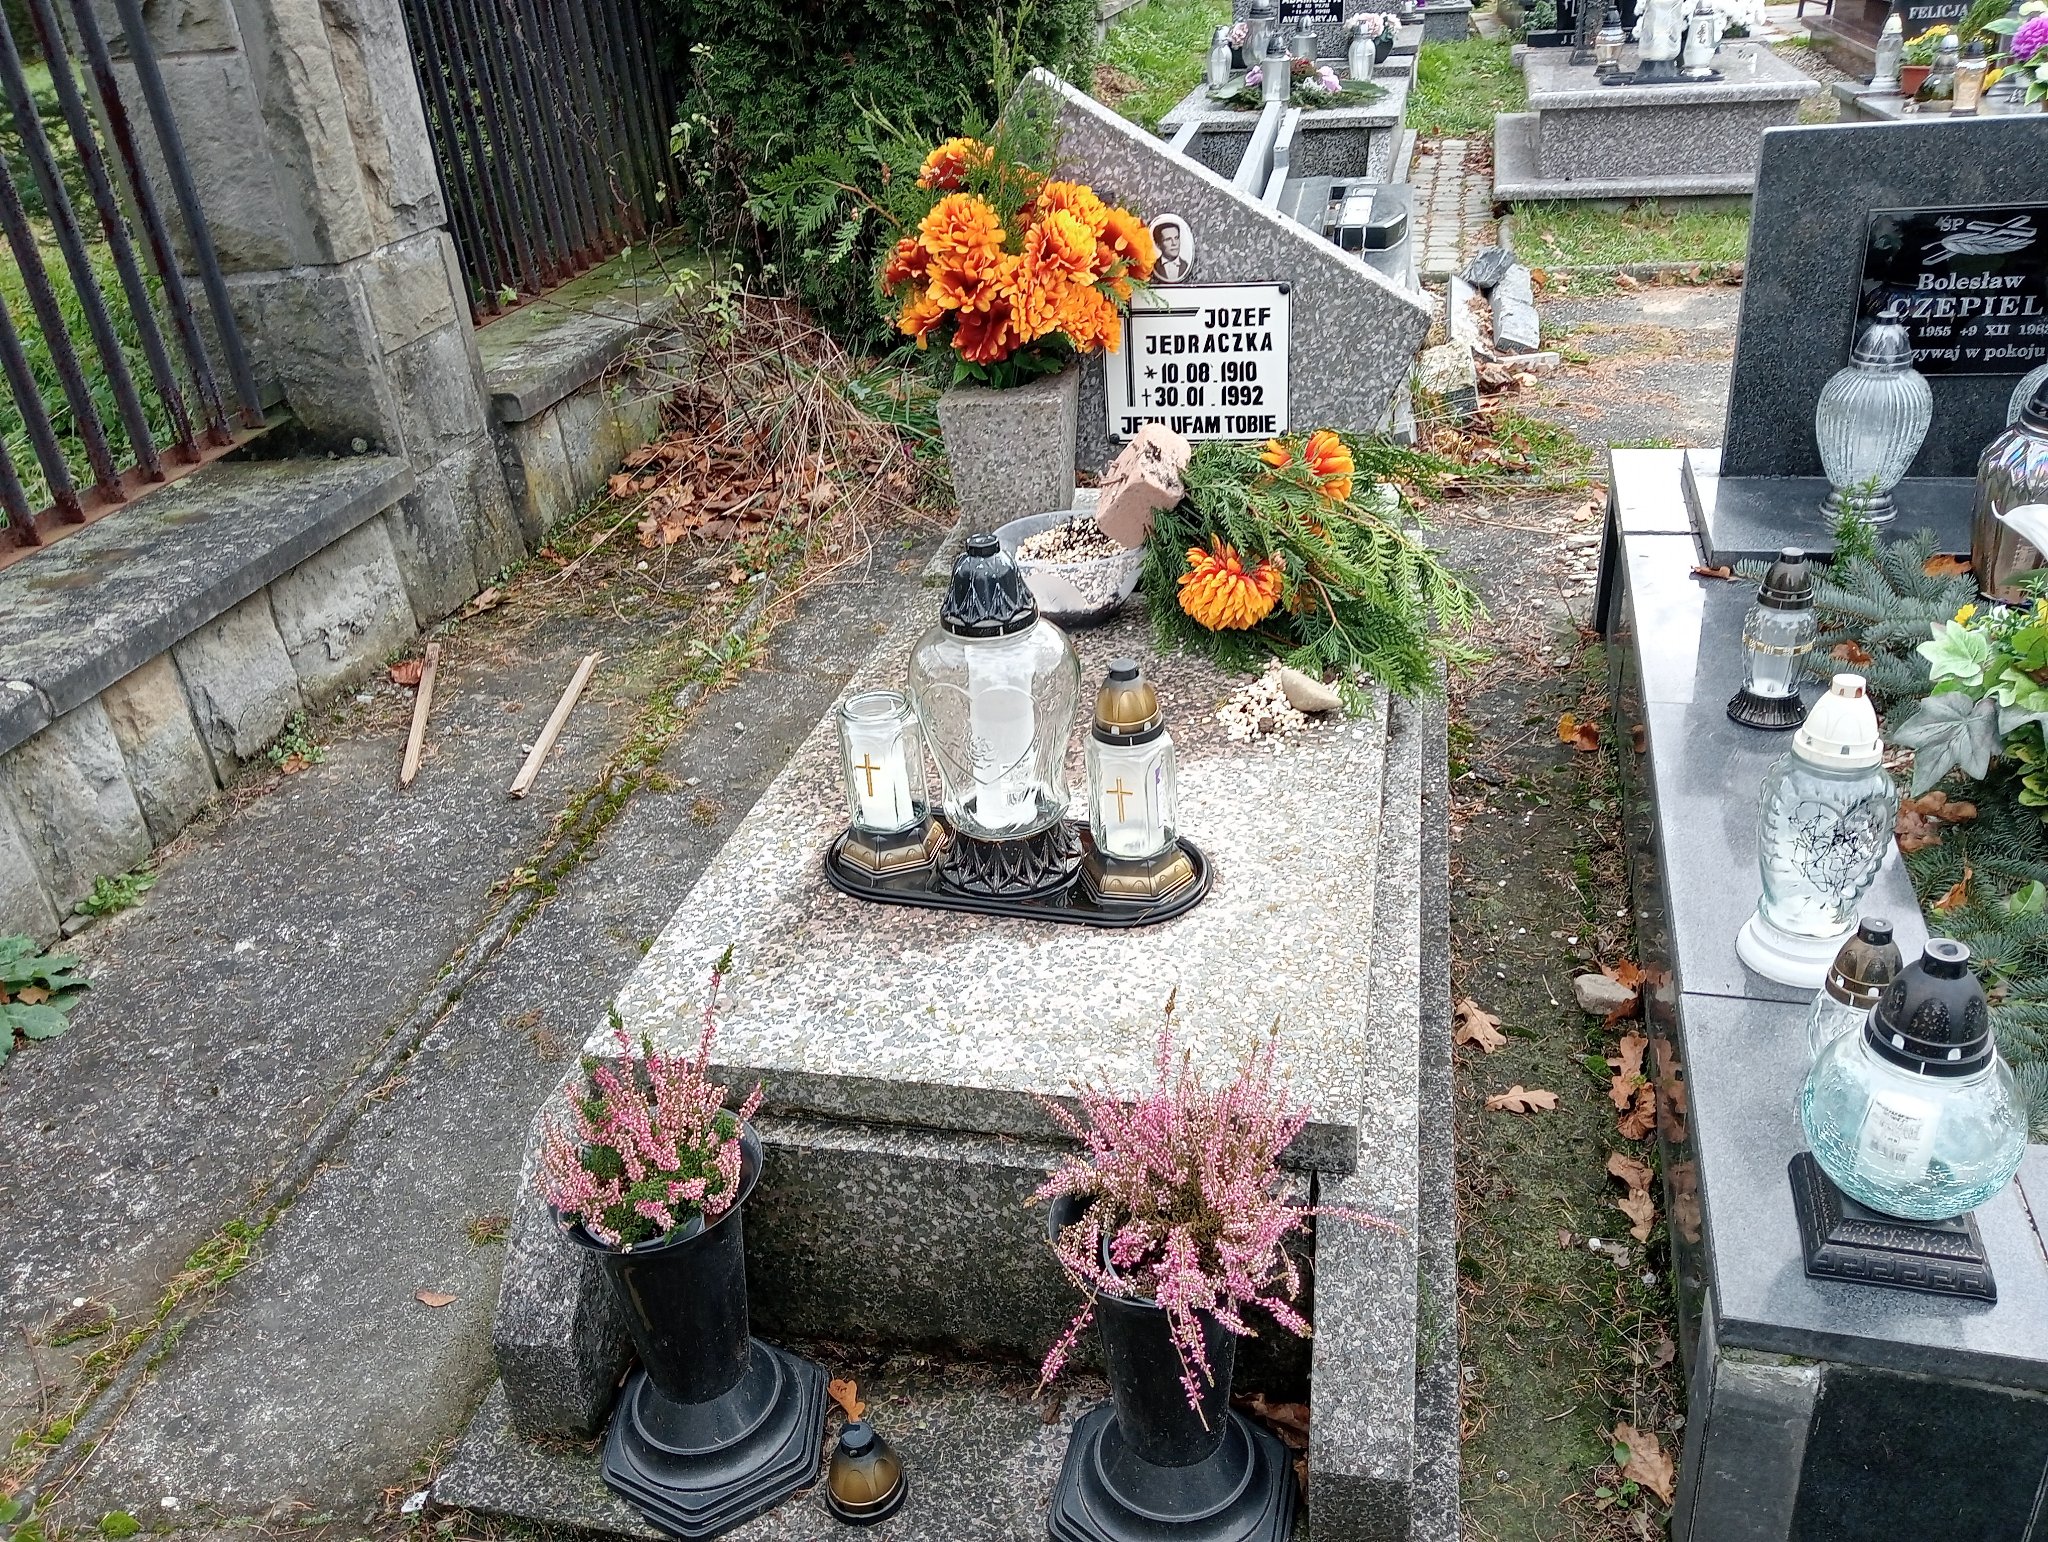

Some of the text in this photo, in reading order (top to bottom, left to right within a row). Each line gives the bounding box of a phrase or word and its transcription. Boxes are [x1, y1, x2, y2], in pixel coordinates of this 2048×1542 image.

[1281, 15, 1338, 24] AVE ARYJA
[1908, 4, 1968, 20] FELICJA
[1915, 271, 2026, 291] Bolesław
[1889, 295, 2044, 319] CZEPIEL
[1918, 325, 1952, 338] 1955
[1984, 324, 2011, 336] XII
[1910, 343, 2046, 362] zywaj w pokoju
[1170, 415, 1221, 435] UFAM
[1224, 414, 1277, 434] TOBIE
